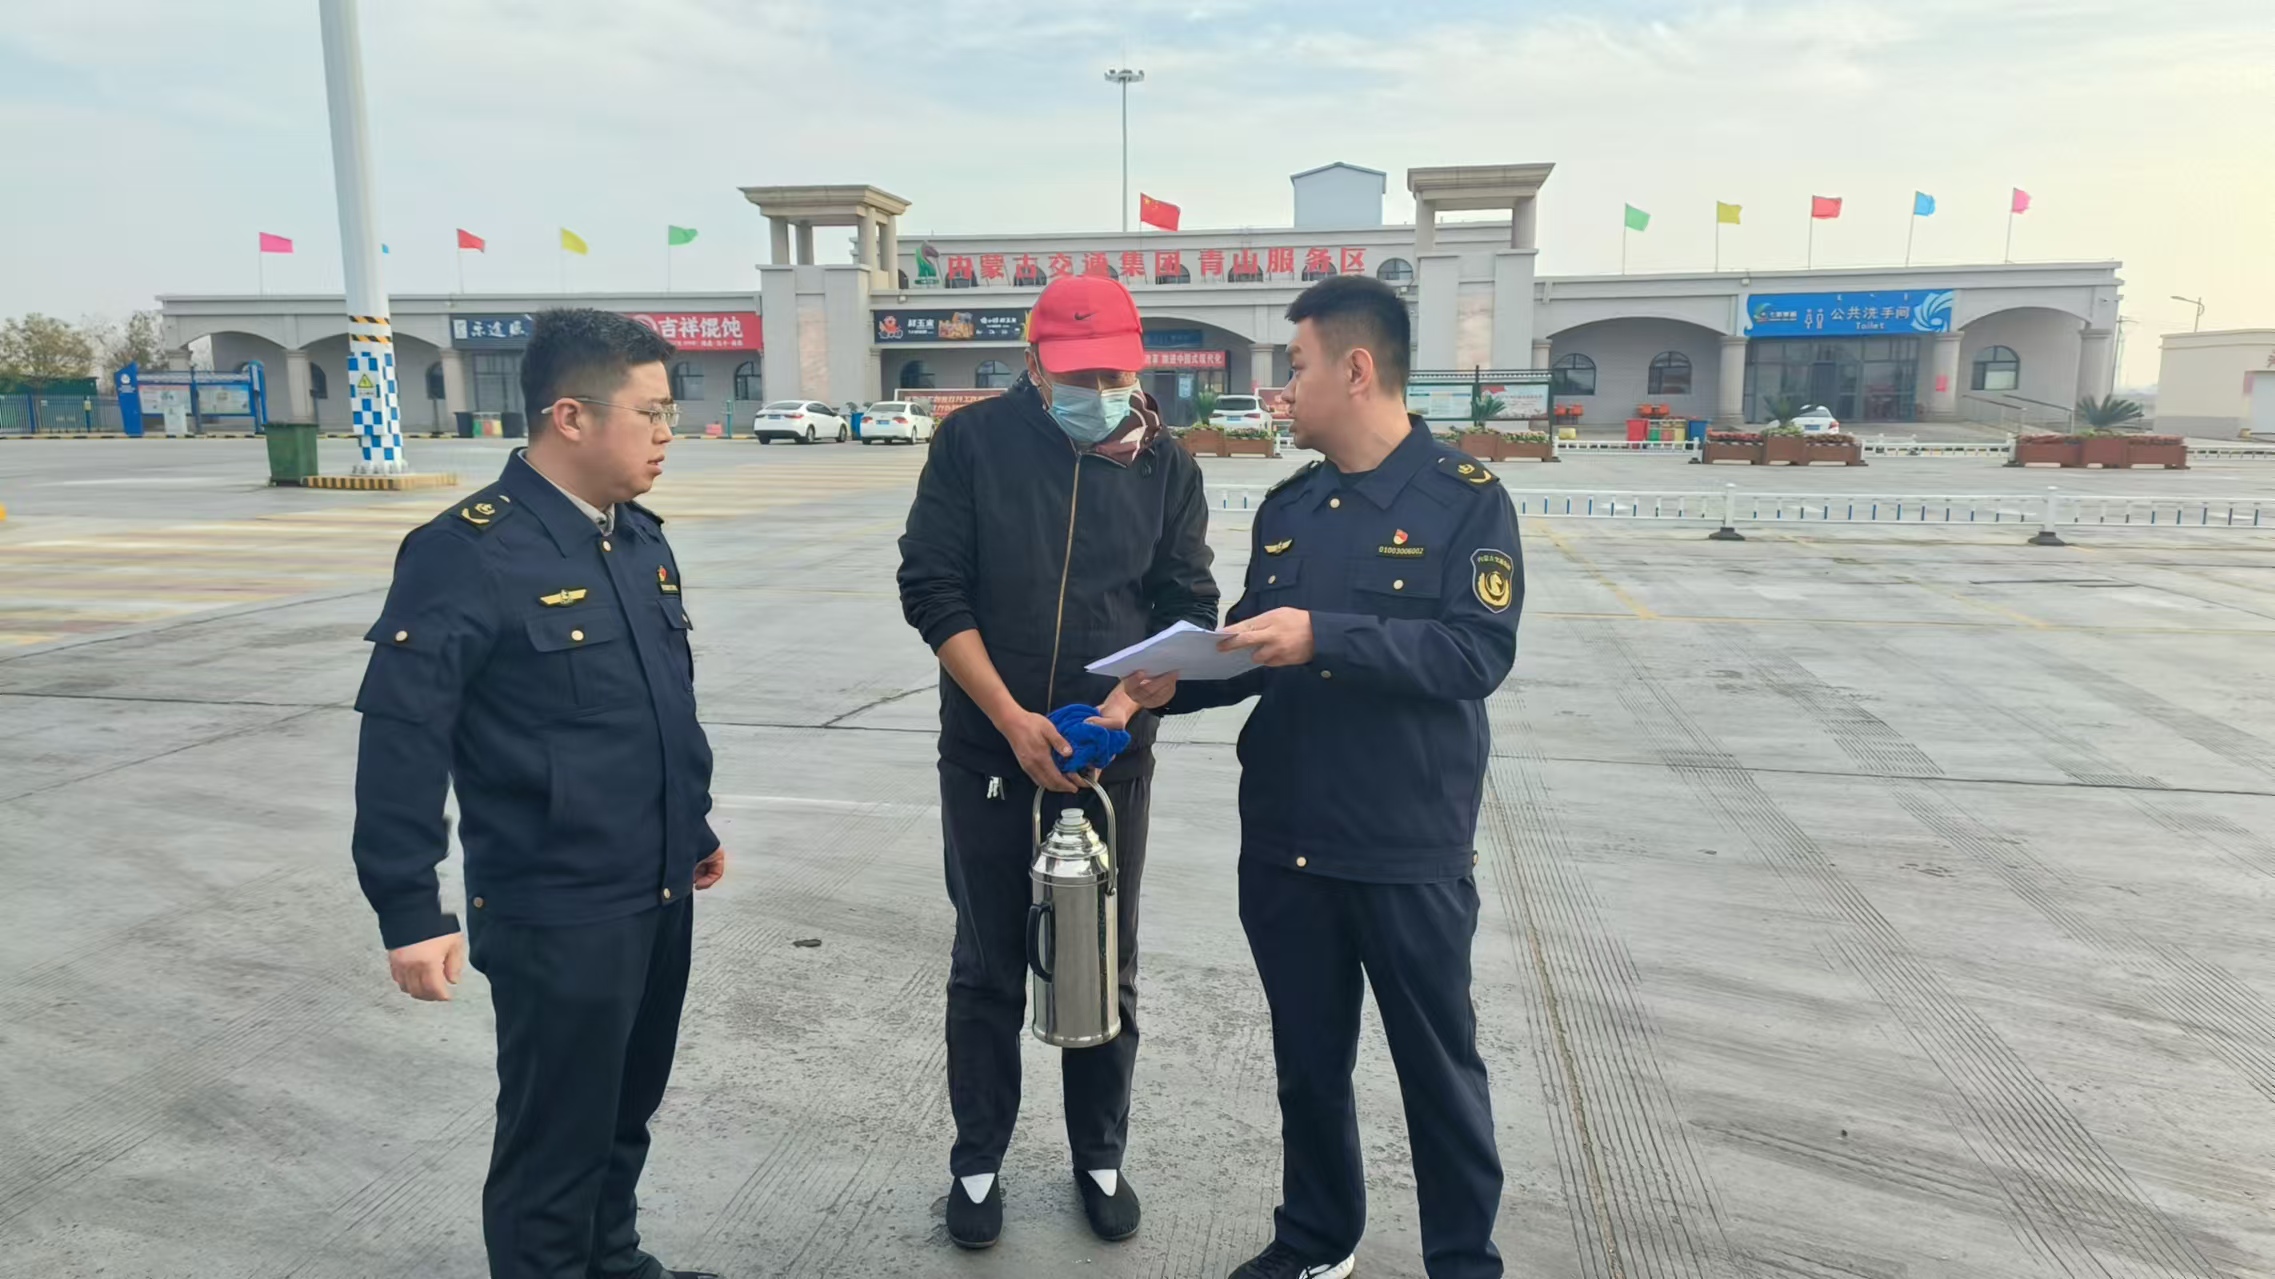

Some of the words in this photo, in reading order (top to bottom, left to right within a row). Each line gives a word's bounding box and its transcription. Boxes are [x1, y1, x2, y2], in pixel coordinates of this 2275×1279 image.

[1830, 306, 1910, 321] 公共洗手间
[658, 316, 744, 339] 吉祥馄饨
[1856, 322, 1885, 330] Toilet
